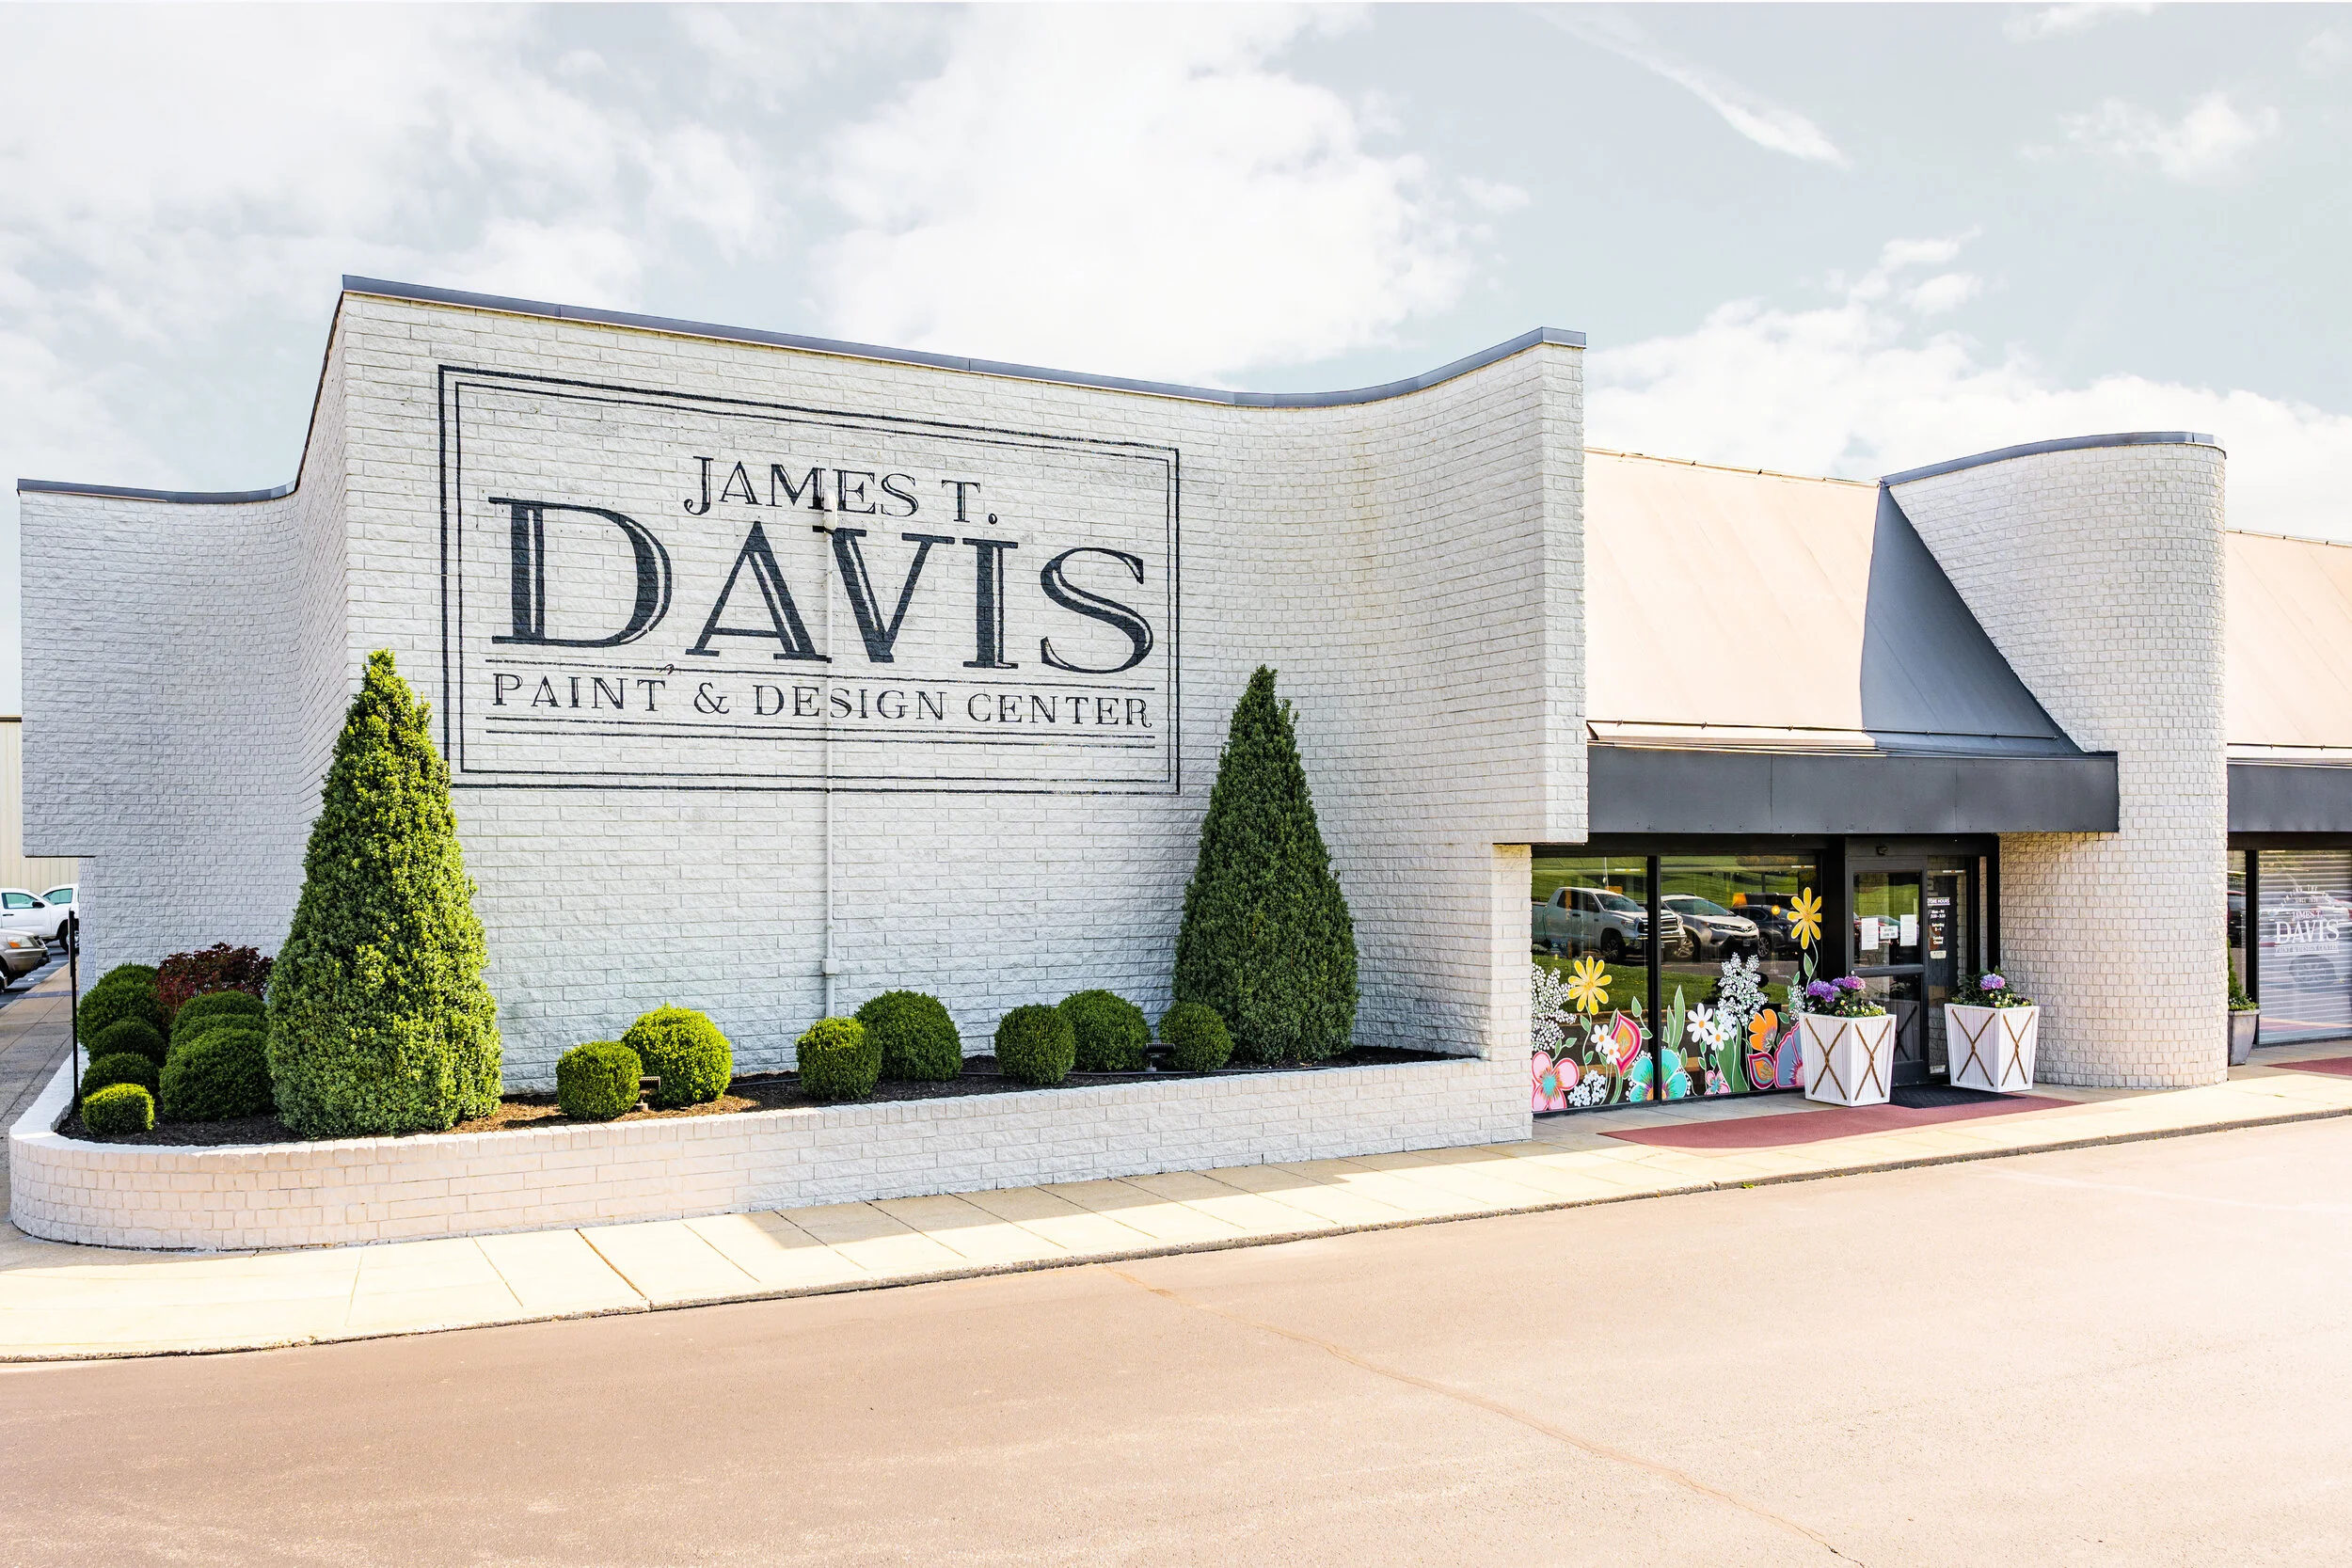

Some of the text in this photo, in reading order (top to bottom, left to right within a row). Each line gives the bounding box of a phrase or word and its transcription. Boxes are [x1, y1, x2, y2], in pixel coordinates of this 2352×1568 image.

[684, 455, 998, 525] JAMES T.
[488, 497, 1153, 674] DAVIS
[492, 673, 1153, 728] PAINT & DESIGN CENTER
[2275, 919, 2340, 943] DAVIS
[2292, 911, 2315, 921] JAMES
